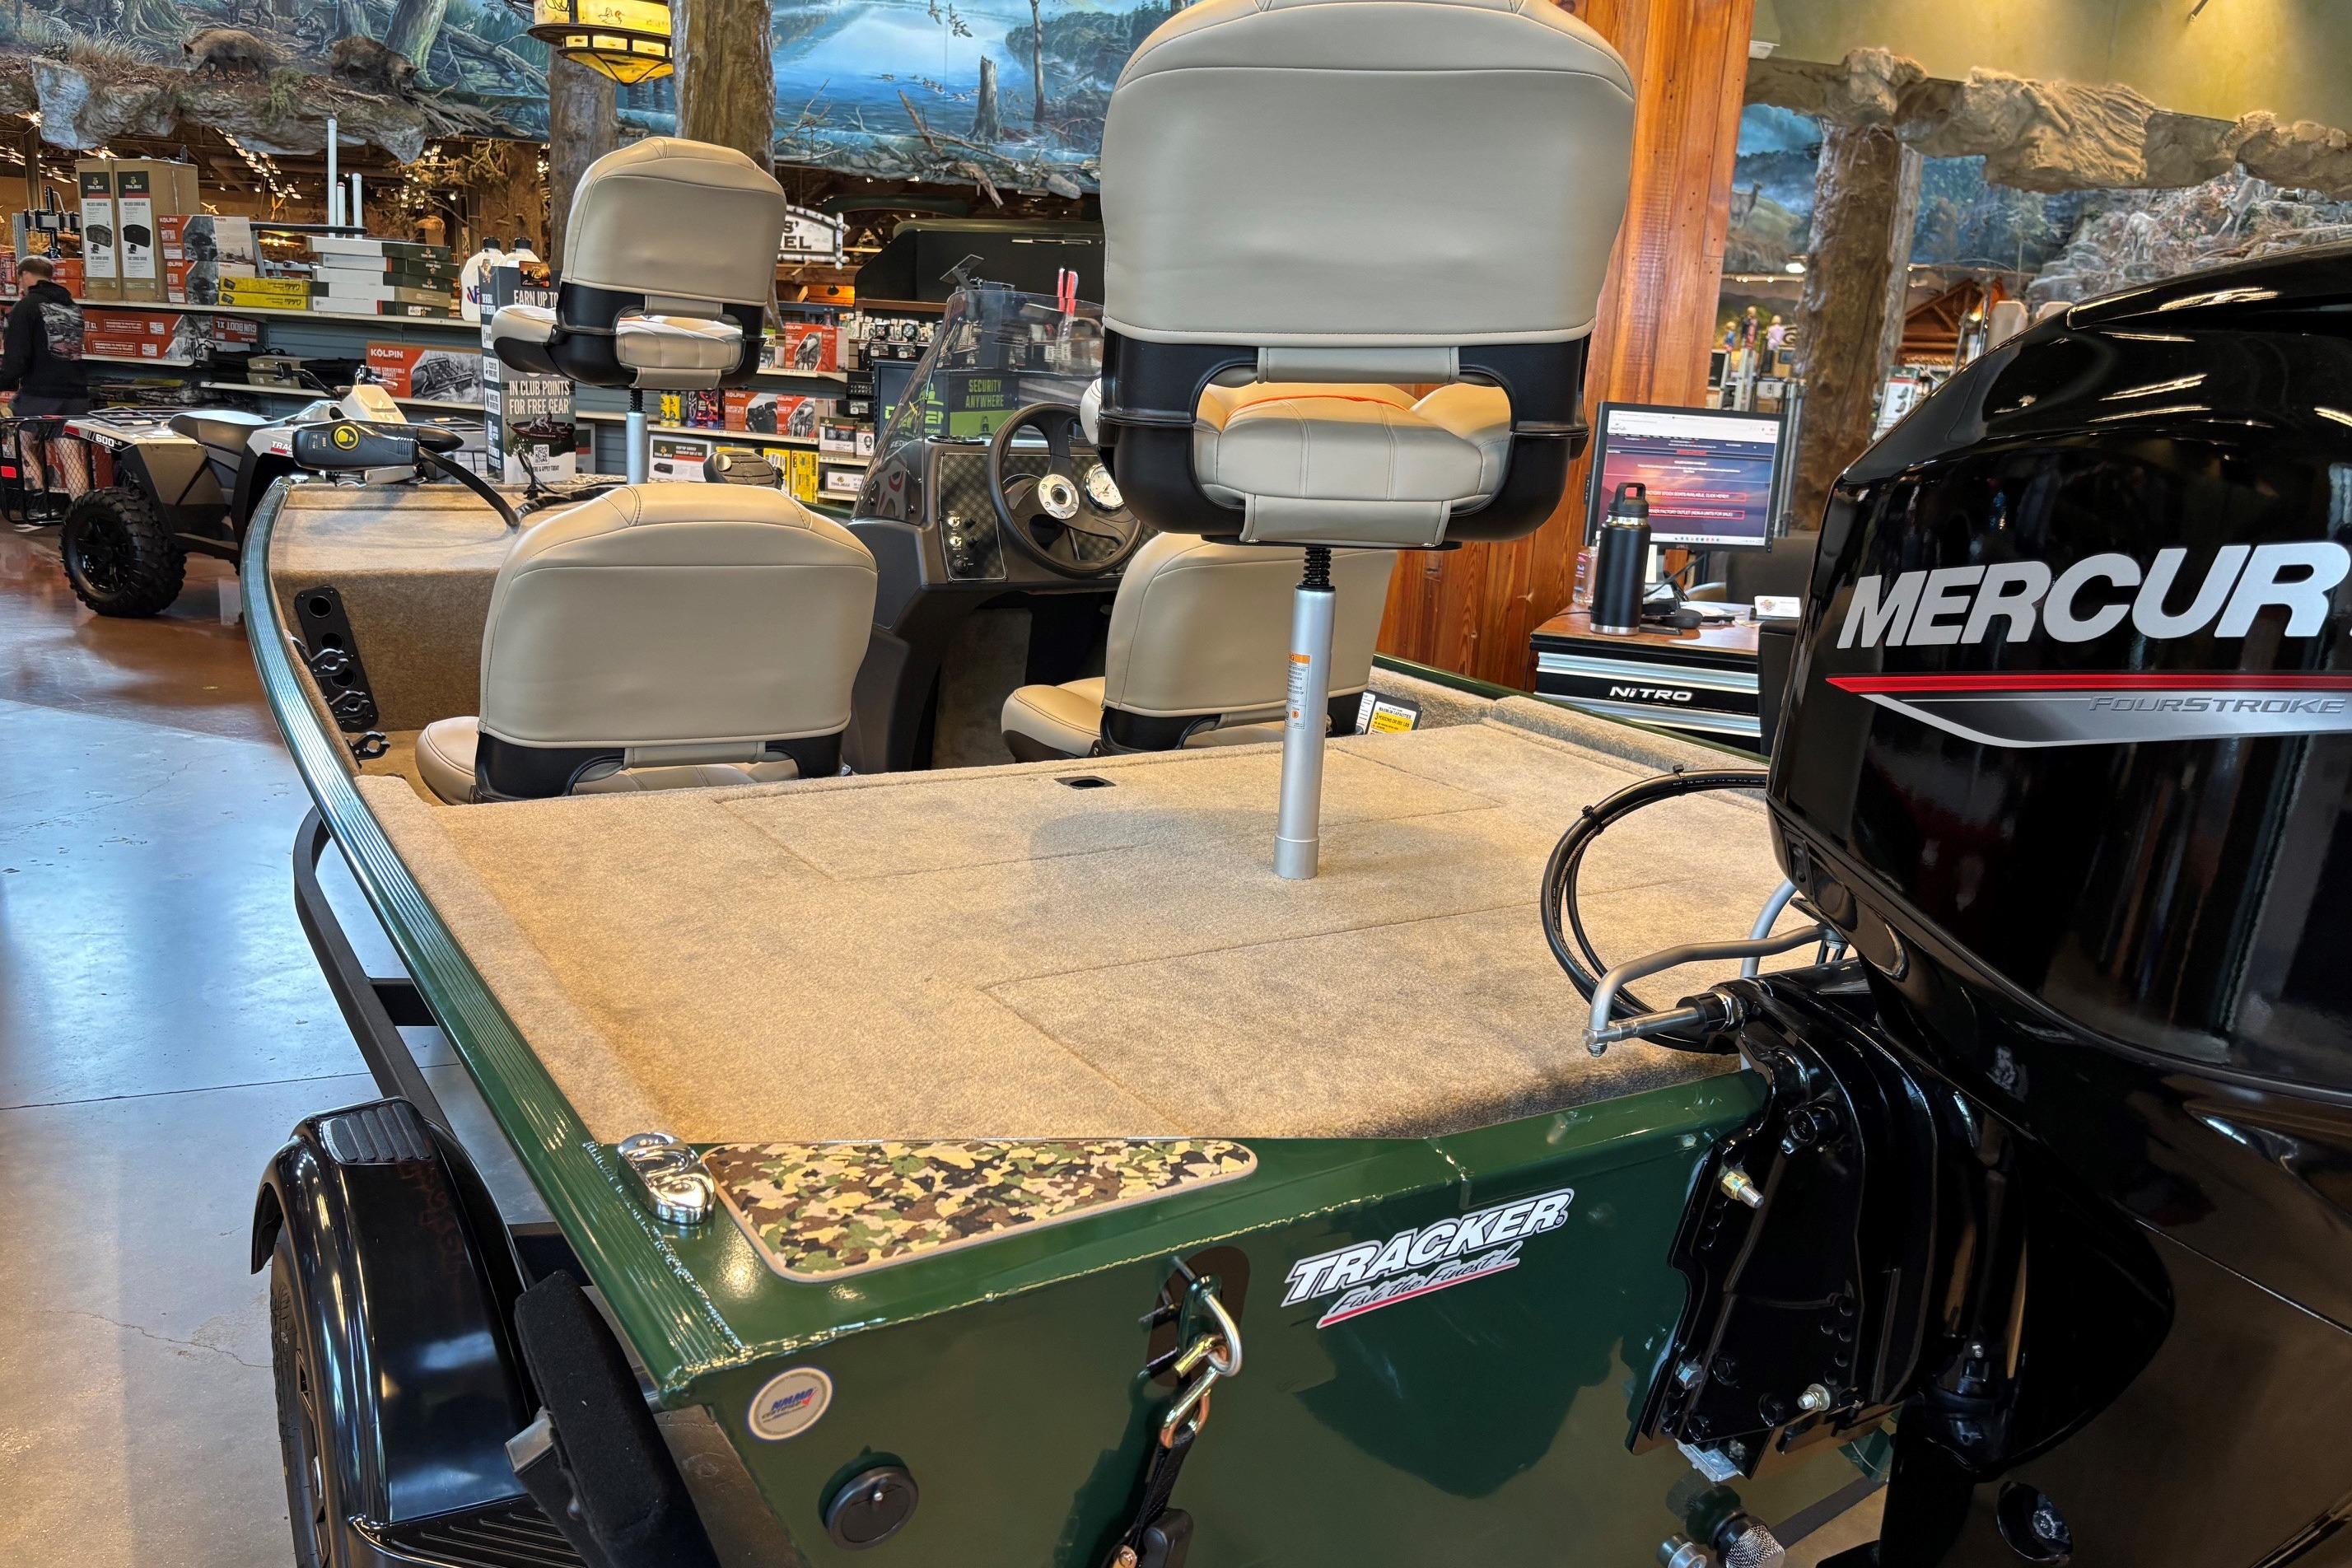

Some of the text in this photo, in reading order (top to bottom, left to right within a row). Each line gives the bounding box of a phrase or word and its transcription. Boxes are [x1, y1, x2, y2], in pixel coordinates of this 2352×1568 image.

[514, 290, 559, 307] EARN UP TO
[371, 348, 404, 358] KOLPIN
[509, 380, 570, 395] IN CLUB POINTS
[968, 379, 1001, 393] SECURITY
[509, 399, 526, 414] FOR
[527, 399, 547, 414] FREE
[965, 394, 1004, 408] ANYWHERE
[1836, 542, 2352, 649] MERCUR
[1283, 1191, 1571, 1304] TRACKER
